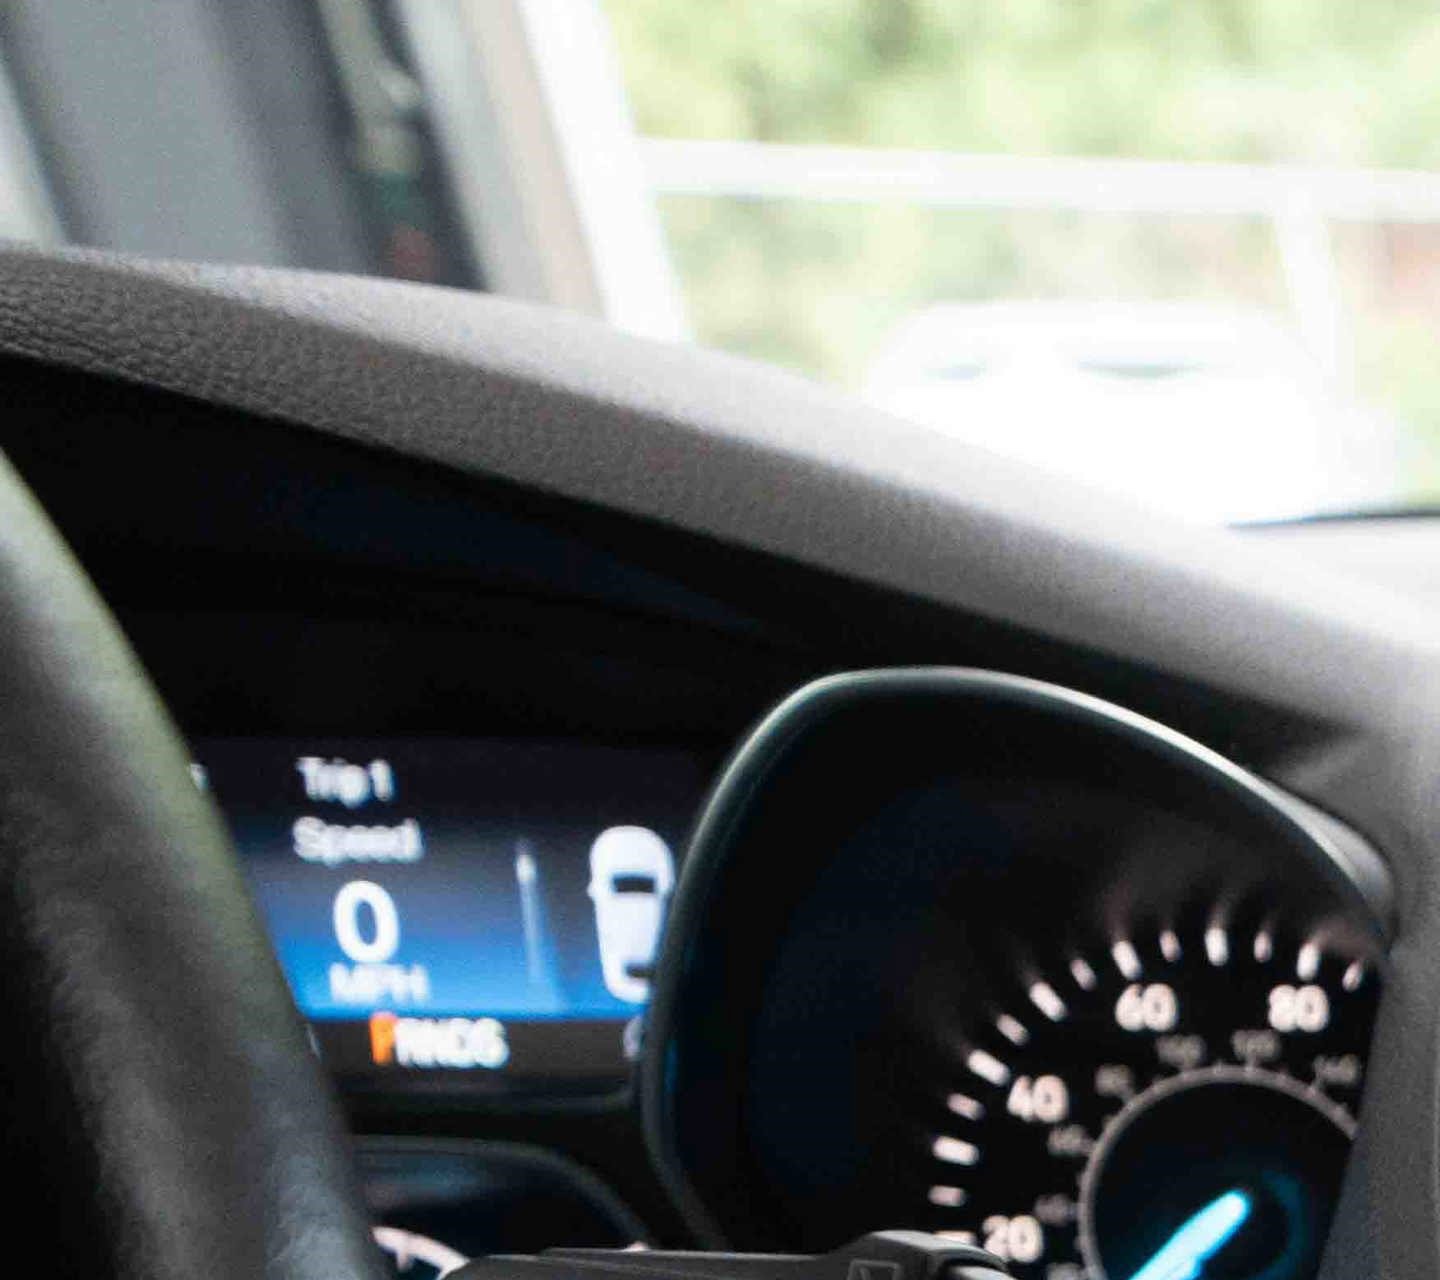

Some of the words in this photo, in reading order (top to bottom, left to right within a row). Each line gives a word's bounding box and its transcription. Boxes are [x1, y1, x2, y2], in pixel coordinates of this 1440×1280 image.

[293, 817, 424, 868] Speed
[332, 880, 399, 964] 0
[1116, 984, 1178, 1031] 60
[1268, 984, 1330, 1032] 80
[1007, 1075, 1068, 1123] 40
[982, 1215, 1044, 1264] 20
